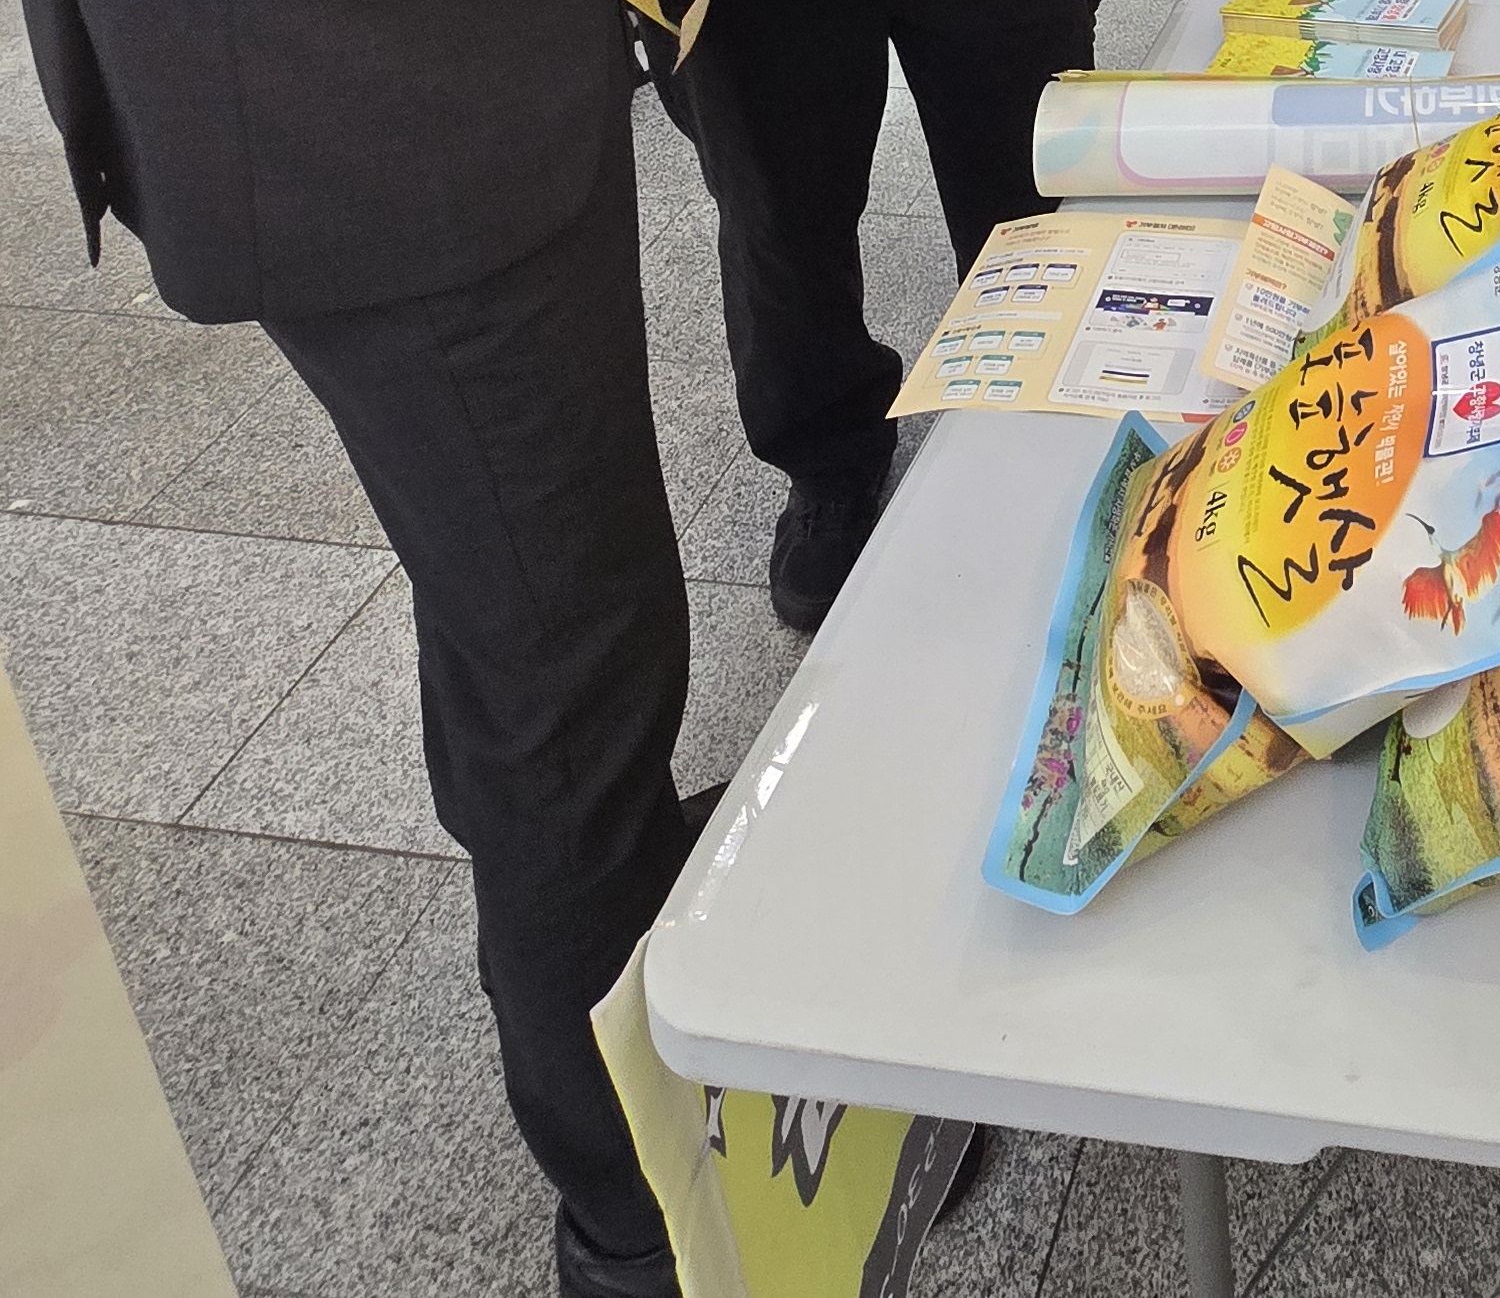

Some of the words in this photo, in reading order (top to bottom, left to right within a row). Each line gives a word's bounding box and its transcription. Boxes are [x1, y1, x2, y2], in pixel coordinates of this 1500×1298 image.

[1410, 180, 1433, 215] 4kg
[1387, 339, 1406, 398] 살아있는
[1467, 340, 1486, 382] 창녕군
[1380, 403, 1403, 432] 자연사
[1373, 435, 1394, 486] 박물관!
[1194, 493, 1228, 537] 4kg
[1104, 763, 1125, 792] 국내산
